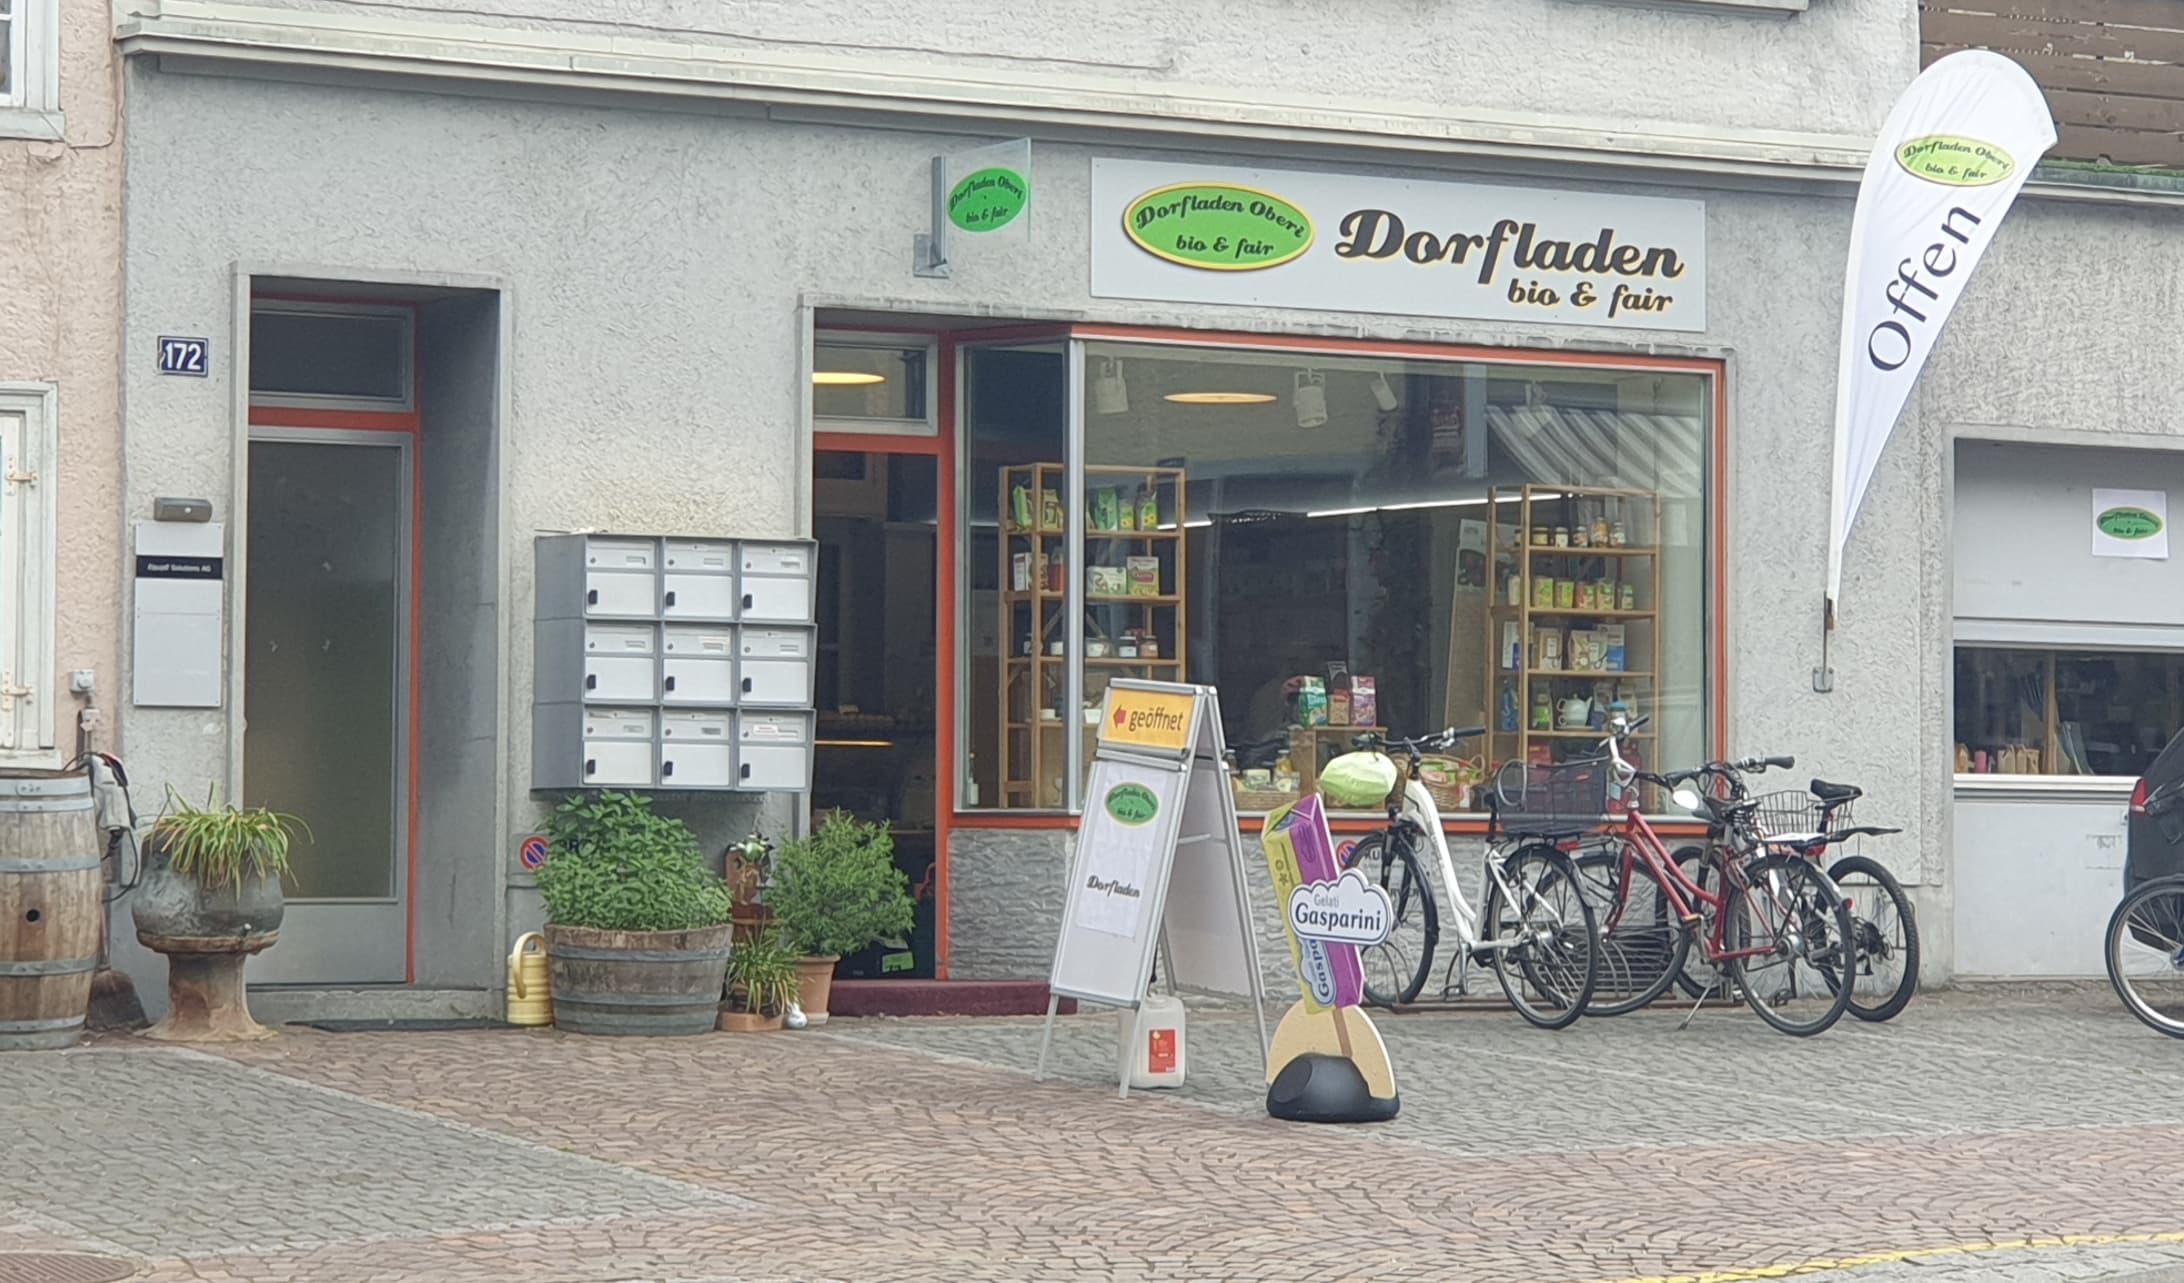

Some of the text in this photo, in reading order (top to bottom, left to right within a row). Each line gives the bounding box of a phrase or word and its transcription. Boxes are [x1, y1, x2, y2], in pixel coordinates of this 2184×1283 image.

[1903, 141, 1972, 158] Dorfladen
[1925, 163, 1987, 180] bio & fair
[950, 176, 995, 211] Dorfladen
[966, 211, 979, 223] bio
[991, 206, 1008, 223] fair
[1136, 194, 1305, 239] Dorfladen Oberi
[1176, 234, 1274, 259] bio & fair
[1334, 209, 1684, 285] Dorfladen
[1508, 278, 1674, 319] bio & fair
[1867, 206, 1982, 371] Offen
[165, 341, 202, 370] 172
[1128, 706, 1184, 732] geöffnet
[1087, 875, 1140, 897] Dorfladen
[1314, 894, 1340, 907] Gelati
[1295, 902, 1381, 931] Gasparini
